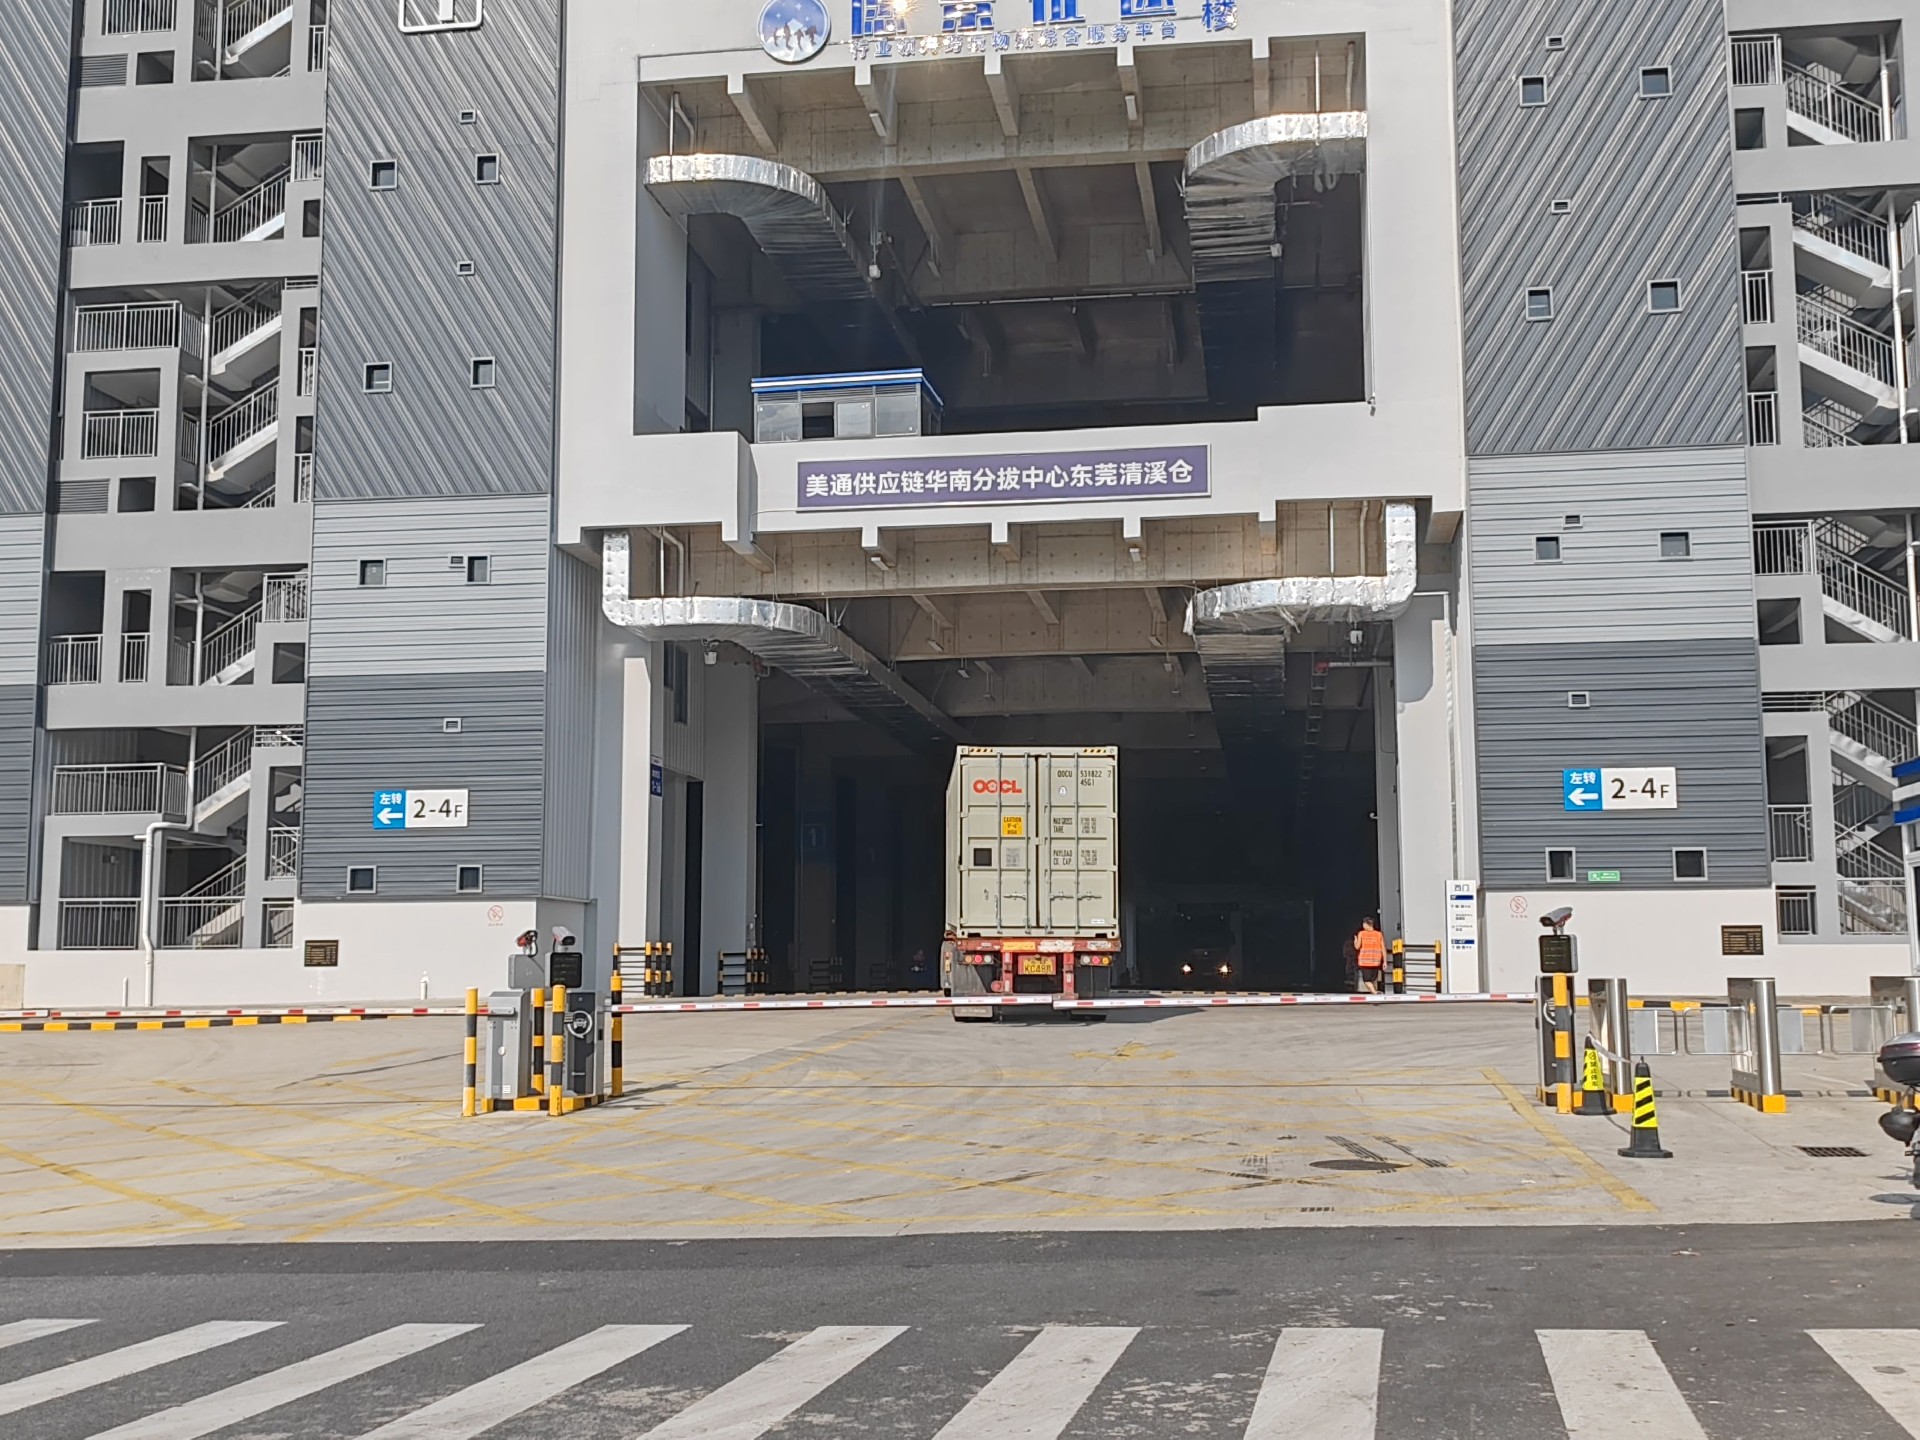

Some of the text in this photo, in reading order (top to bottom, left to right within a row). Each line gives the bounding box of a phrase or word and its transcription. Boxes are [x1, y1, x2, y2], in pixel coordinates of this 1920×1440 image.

[1080, 769, 1103, 778] 531822
[1569, 771, 1597, 785] 左转
[973, 779, 1023, 794] OOCL
[1610, 777, 1671, 799] 2-4F
[379, 792, 403, 806] 左转
[413, 798, 464, 819] 2-4F
